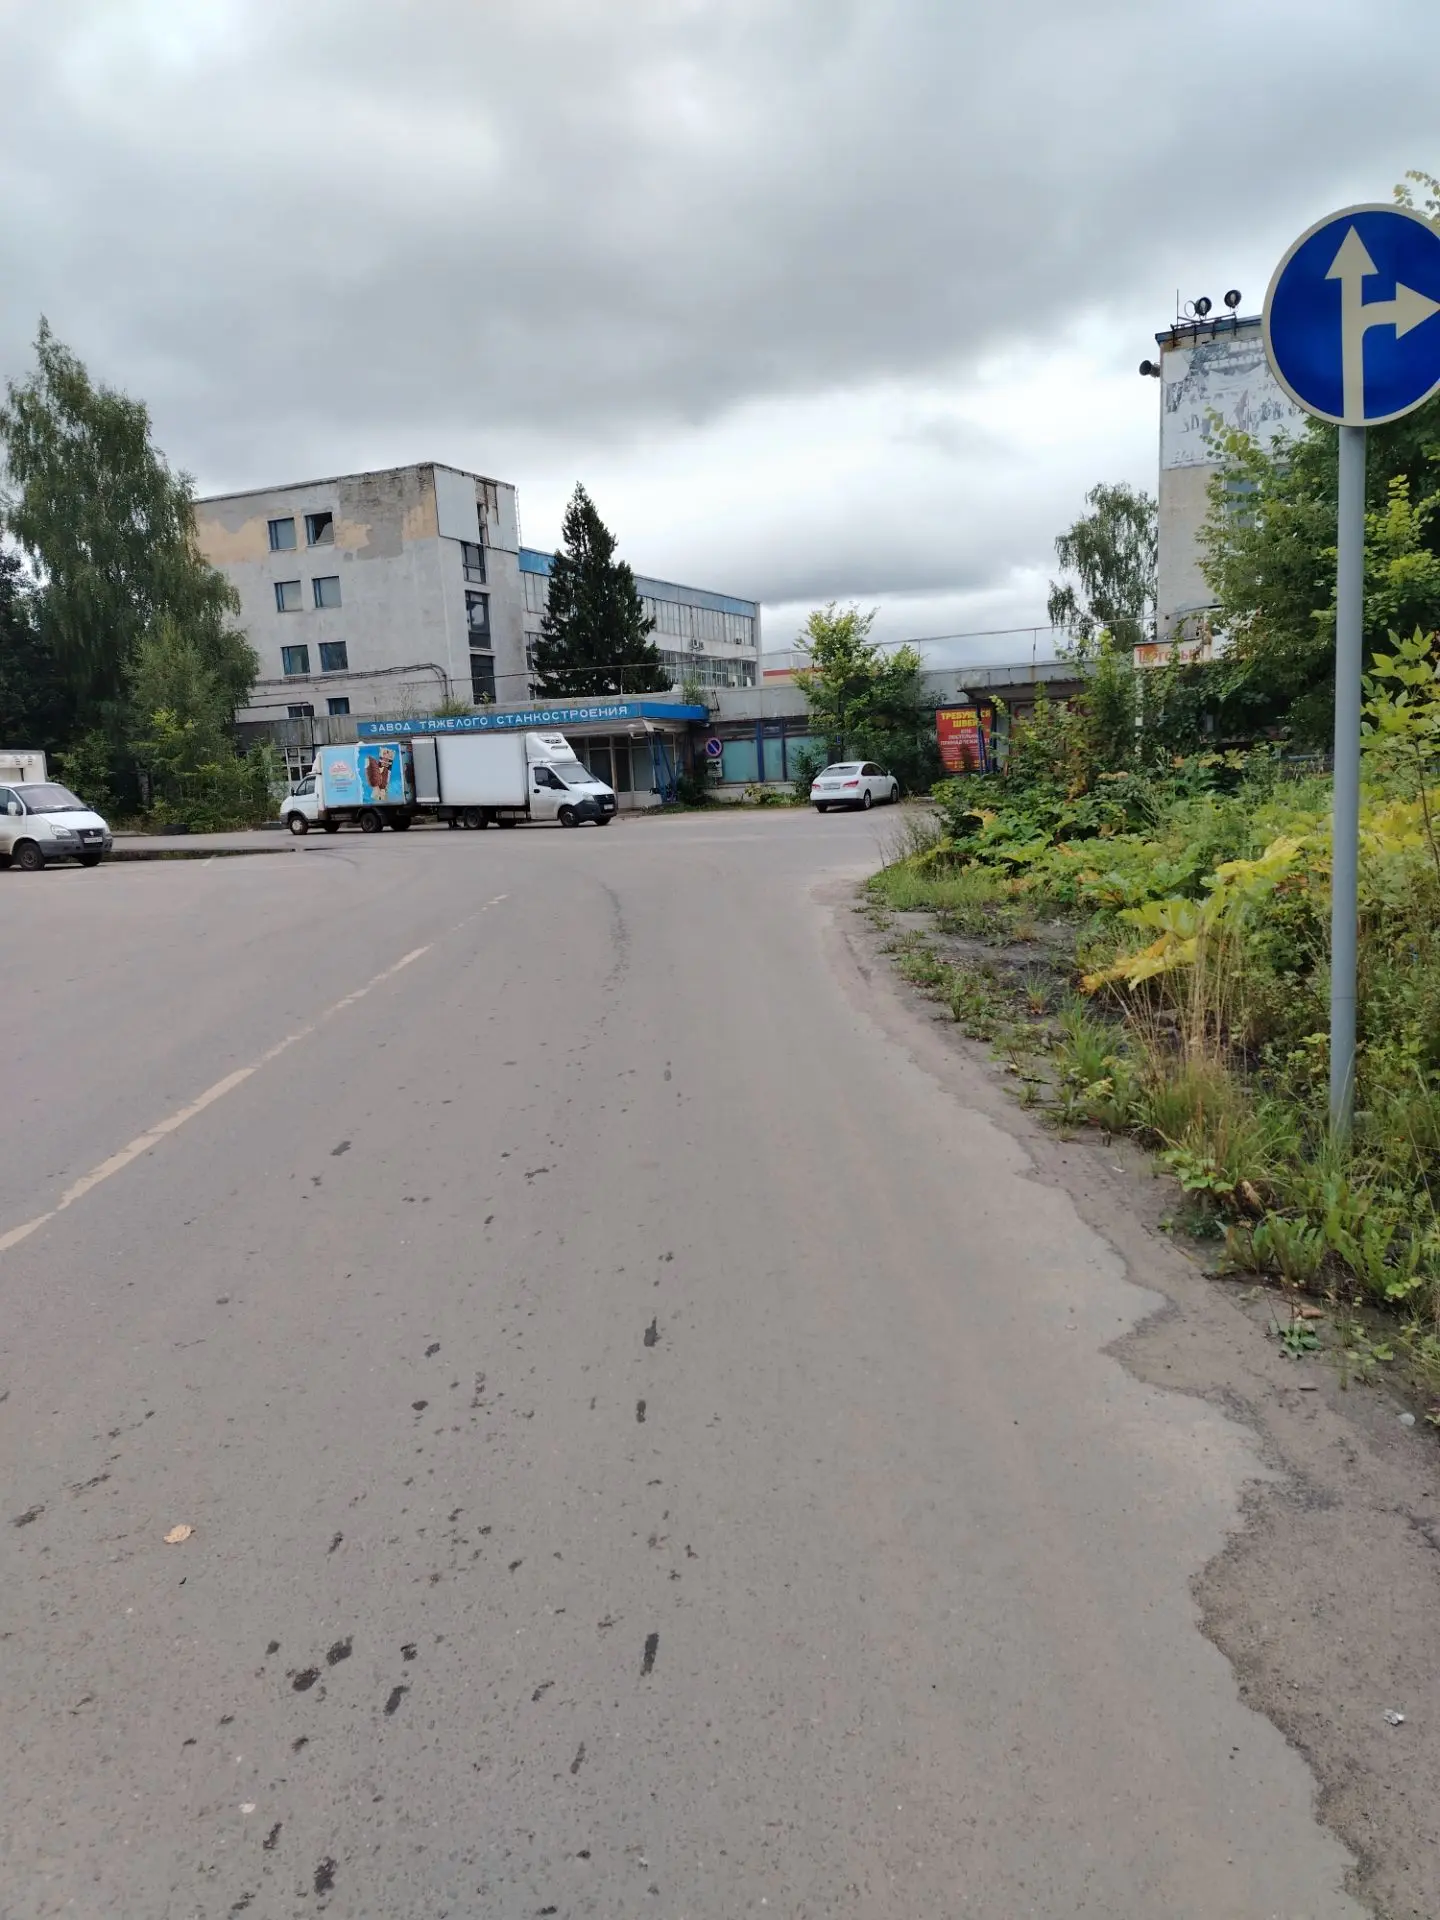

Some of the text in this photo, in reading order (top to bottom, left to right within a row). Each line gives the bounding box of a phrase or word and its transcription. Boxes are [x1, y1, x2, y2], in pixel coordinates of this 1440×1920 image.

[370, 706, 628, 732] ЗАВОД ТЯЖЕЛОГО СТАНКОСТРОЕНИЯ
[941, 710, 991, 720] ТРЕБУЮСЯ
